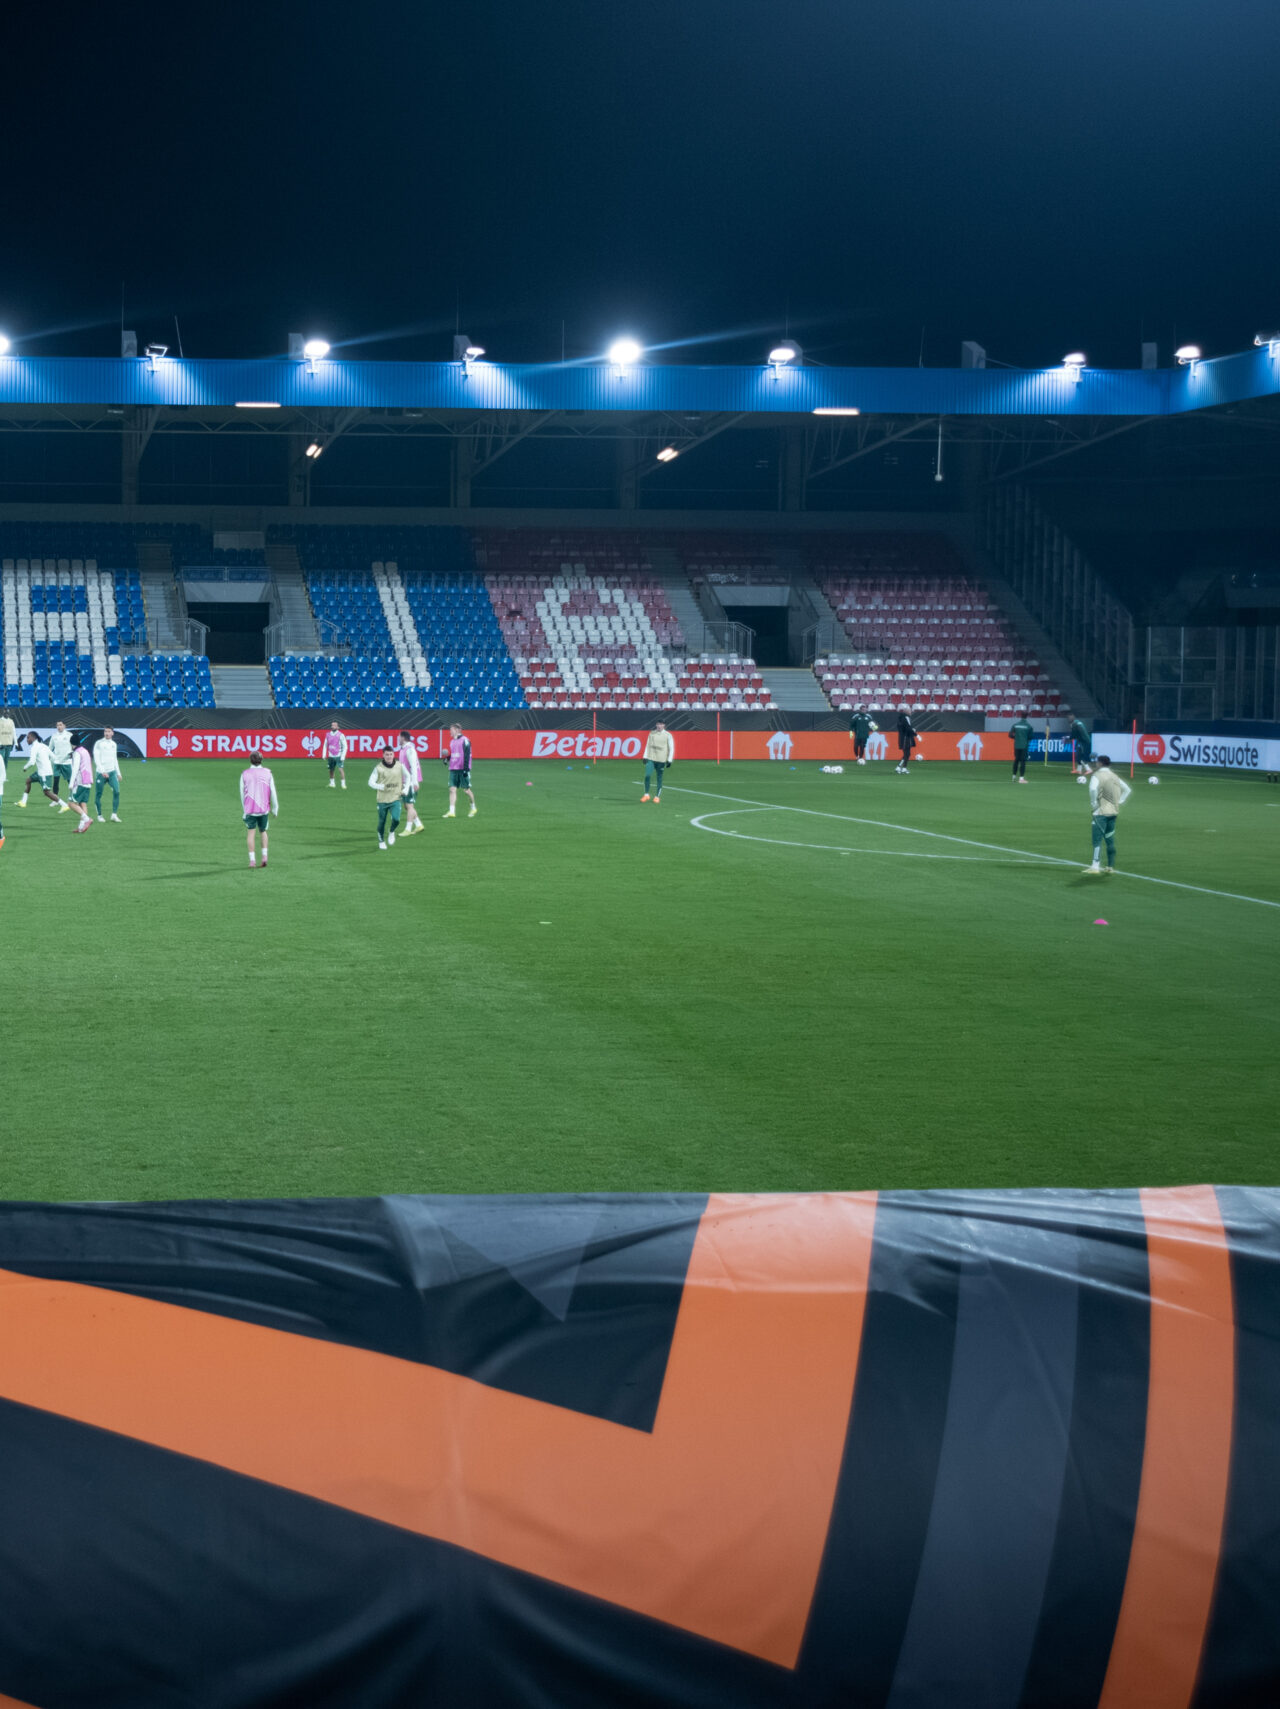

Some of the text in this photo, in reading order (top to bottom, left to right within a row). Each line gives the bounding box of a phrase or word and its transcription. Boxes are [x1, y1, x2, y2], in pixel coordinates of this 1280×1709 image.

[191, 735, 287, 752] STRAUSS
[342, 735, 429, 752] TRAUS
[532, 732, 642, 757] Betano
[1170, 736, 1259, 767] Swissquote
